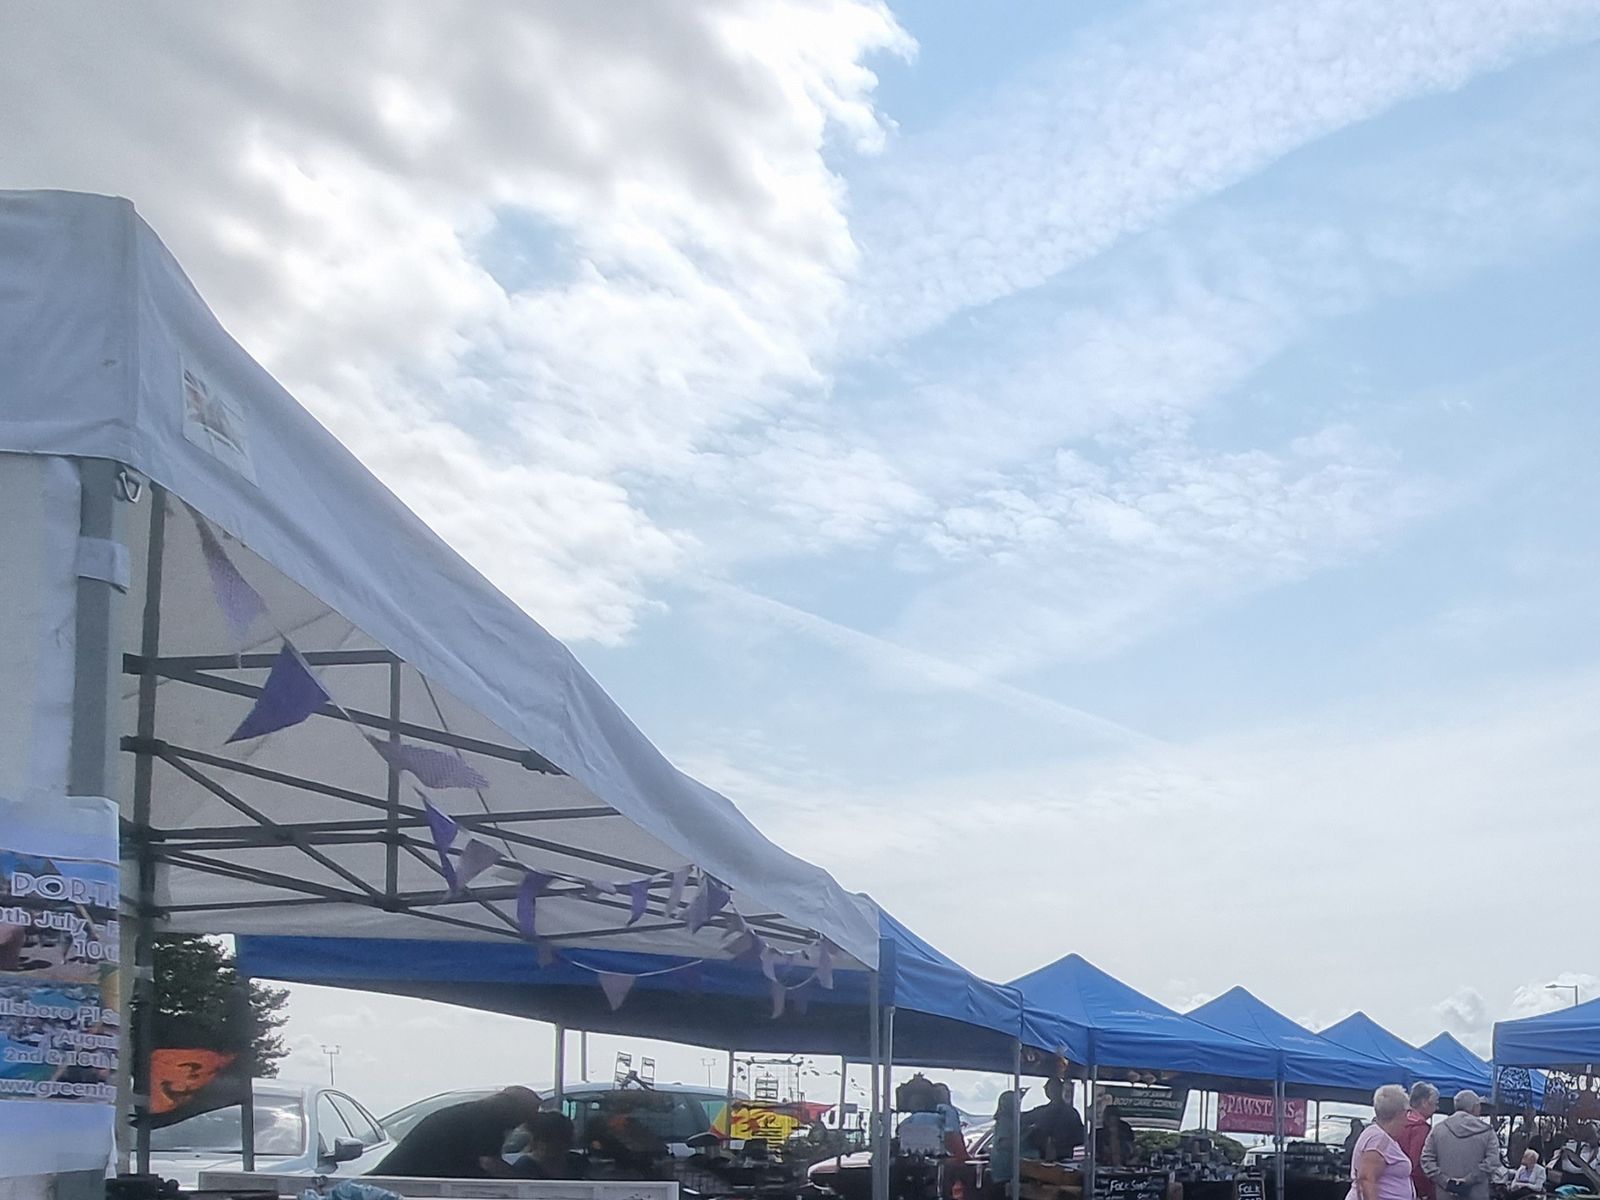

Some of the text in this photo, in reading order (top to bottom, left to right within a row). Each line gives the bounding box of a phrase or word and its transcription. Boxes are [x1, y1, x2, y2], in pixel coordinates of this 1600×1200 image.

[34, 910, 87, 935] July
[4, 1048, 43, 1063] 2nd
[1227, 1094, 1295, 1118] PAWSTS
